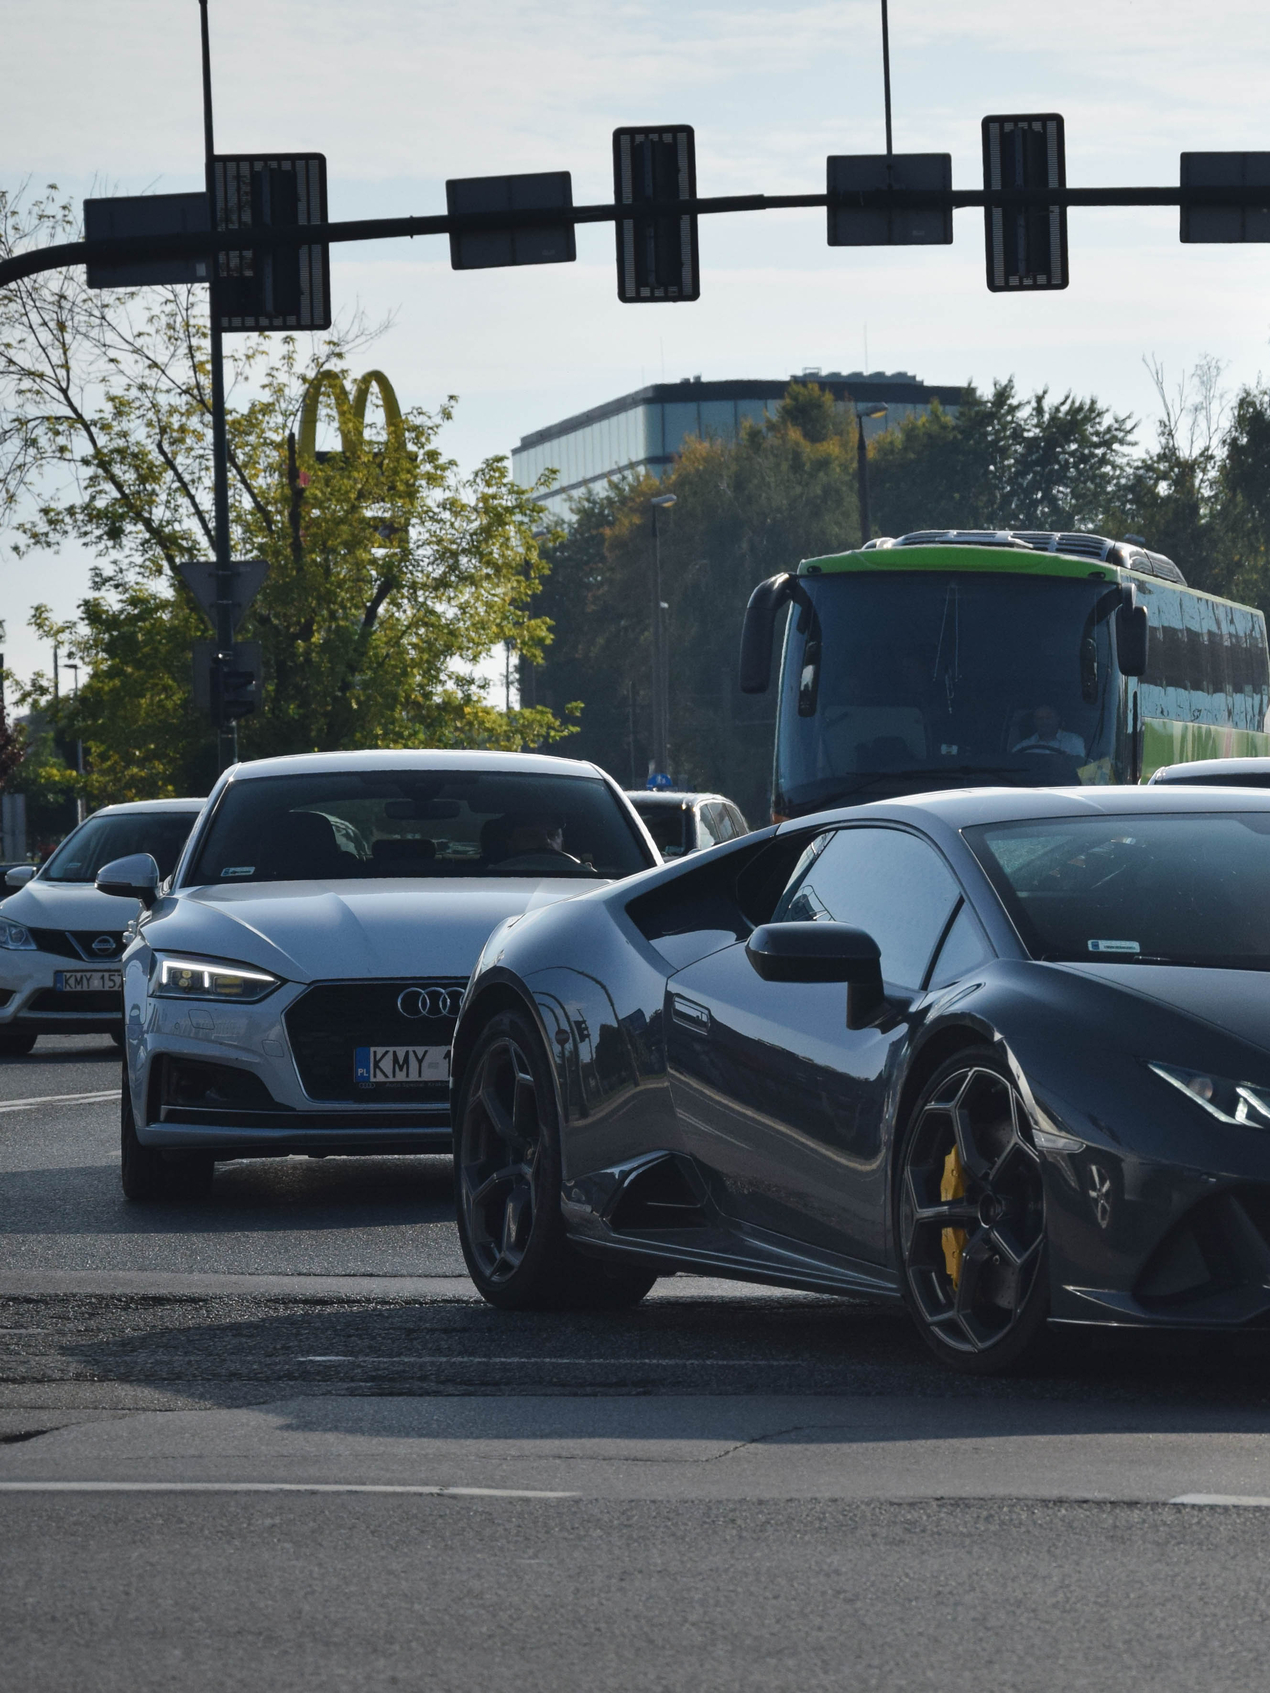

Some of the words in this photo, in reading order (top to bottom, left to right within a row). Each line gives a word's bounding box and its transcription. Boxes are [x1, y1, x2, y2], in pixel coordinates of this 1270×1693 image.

[64, 974, 92, 989] KMY
[373, 1049, 428, 1079] KMY
[357, 1068, 369, 1077] PL
